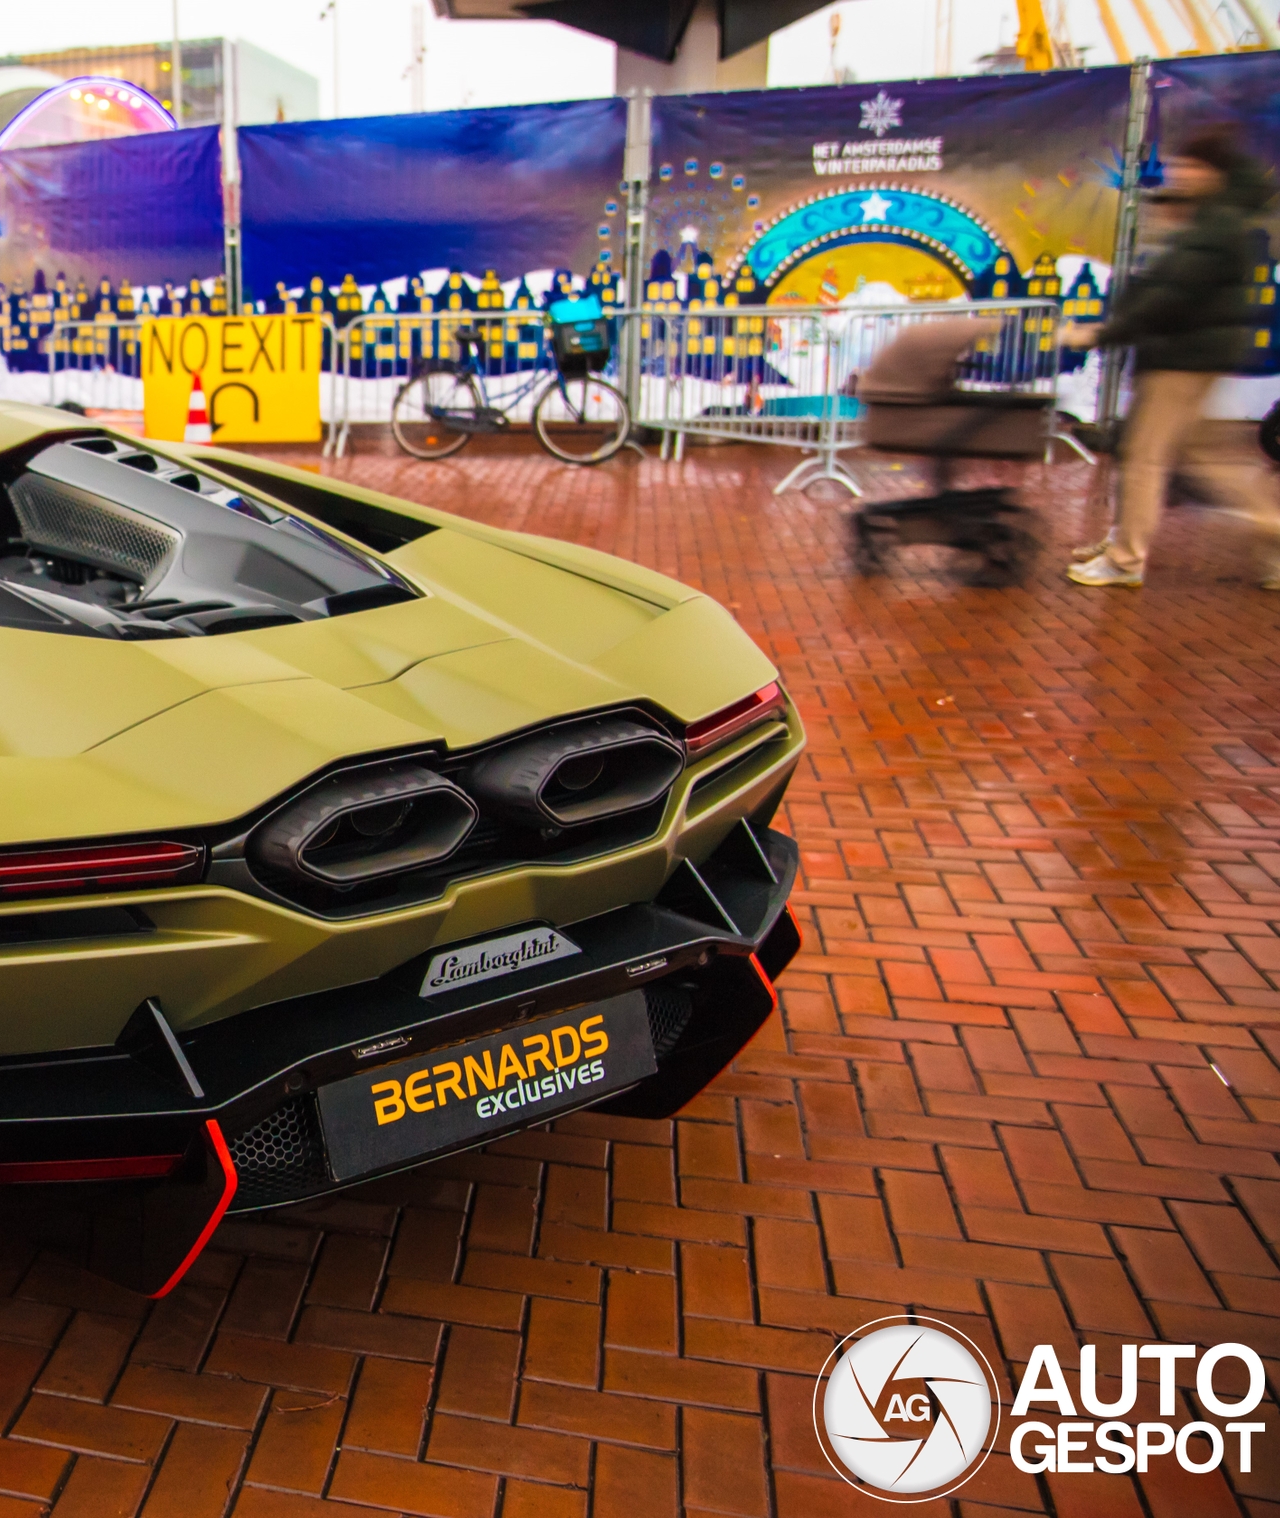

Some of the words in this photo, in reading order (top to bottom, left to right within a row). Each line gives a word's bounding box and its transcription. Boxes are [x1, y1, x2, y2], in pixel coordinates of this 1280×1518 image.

[812, 141, 840, 159] HET
[841, 137, 943, 157] AMSTERDAMSE
[813, 155, 943, 175] WINTERPARADIJS
[148, 322, 208, 375] NO
[221, 318, 315, 374] EXIT
[430, 933, 560, 987] Lamborghini
[371, 1014, 609, 1126] BERNARDS
[476, 1059, 606, 1119] exclusives
